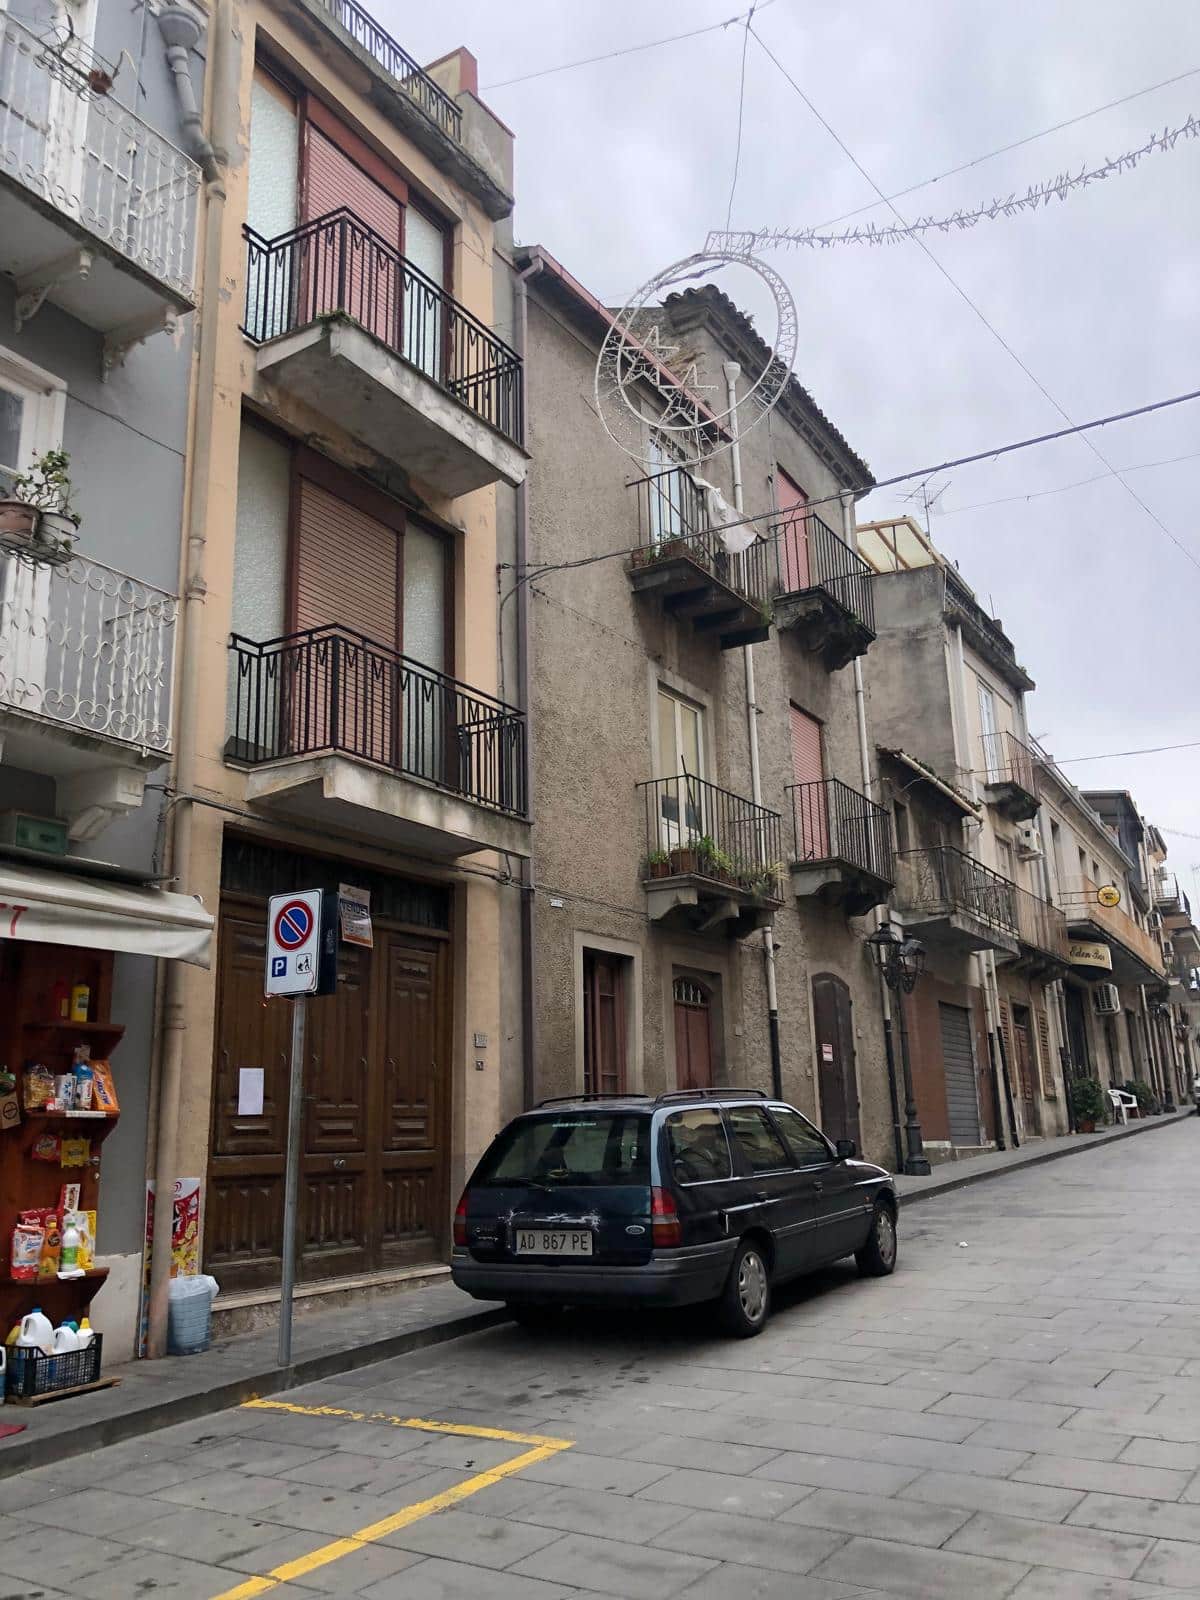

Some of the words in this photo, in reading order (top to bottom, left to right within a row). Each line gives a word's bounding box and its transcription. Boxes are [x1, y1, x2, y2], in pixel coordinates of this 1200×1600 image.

[275, 960, 284, 975] P
[520, 1234, 535, 1250] AD
[543, 1234, 567, 1250] 867
[572, 1233, 589, 1251] PE
